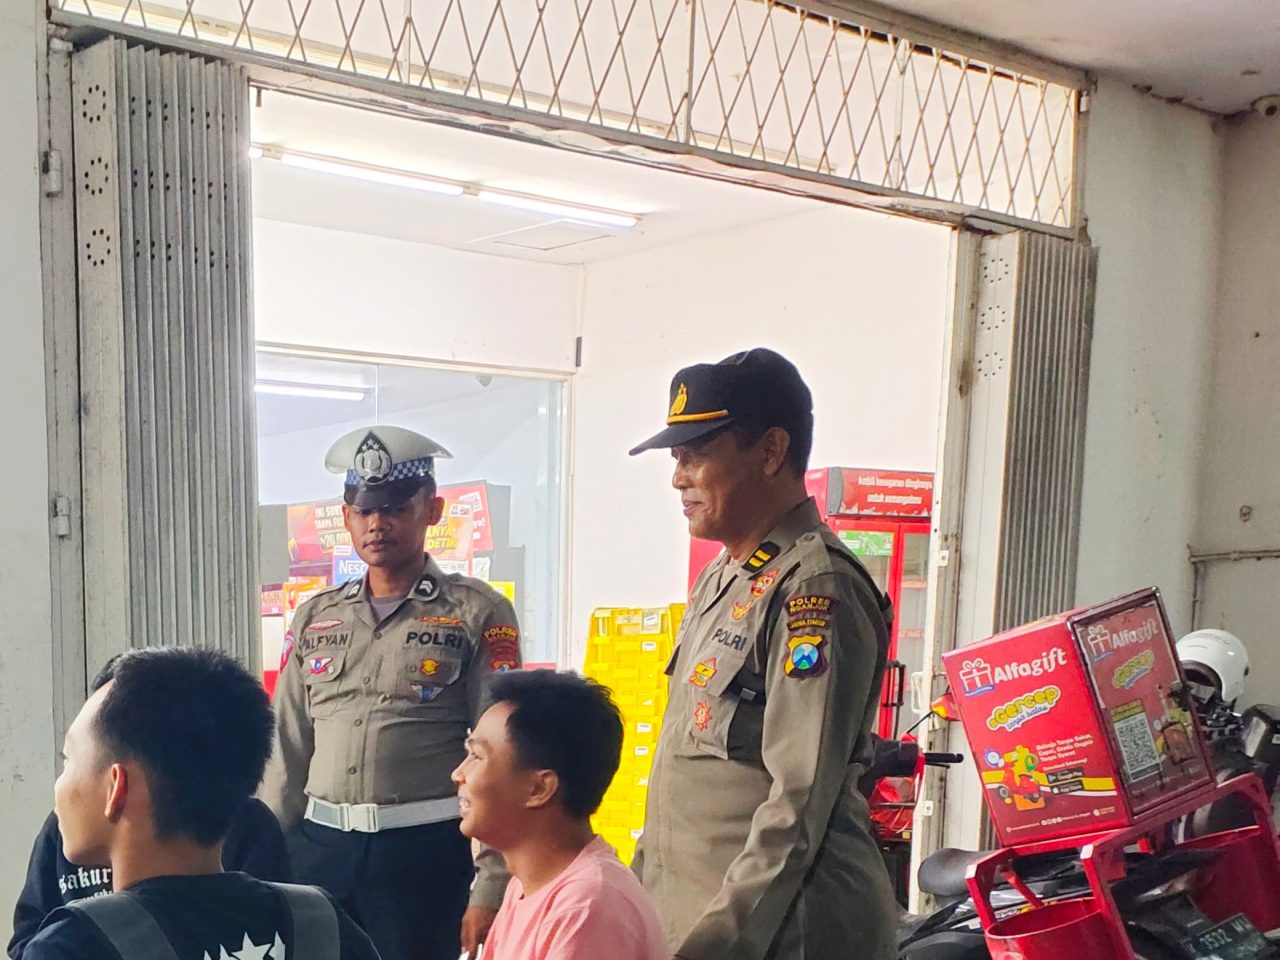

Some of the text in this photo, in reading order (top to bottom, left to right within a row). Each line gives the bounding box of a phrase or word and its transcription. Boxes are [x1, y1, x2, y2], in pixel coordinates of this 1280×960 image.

[789, 596, 831, 607] POLRES
[406, 631, 463, 649] POLRI
[712, 628, 748, 652] POLRI
[1112, 618, 1160, 649] Alfagift
[994, 647, 1067, 684] Alfagift
